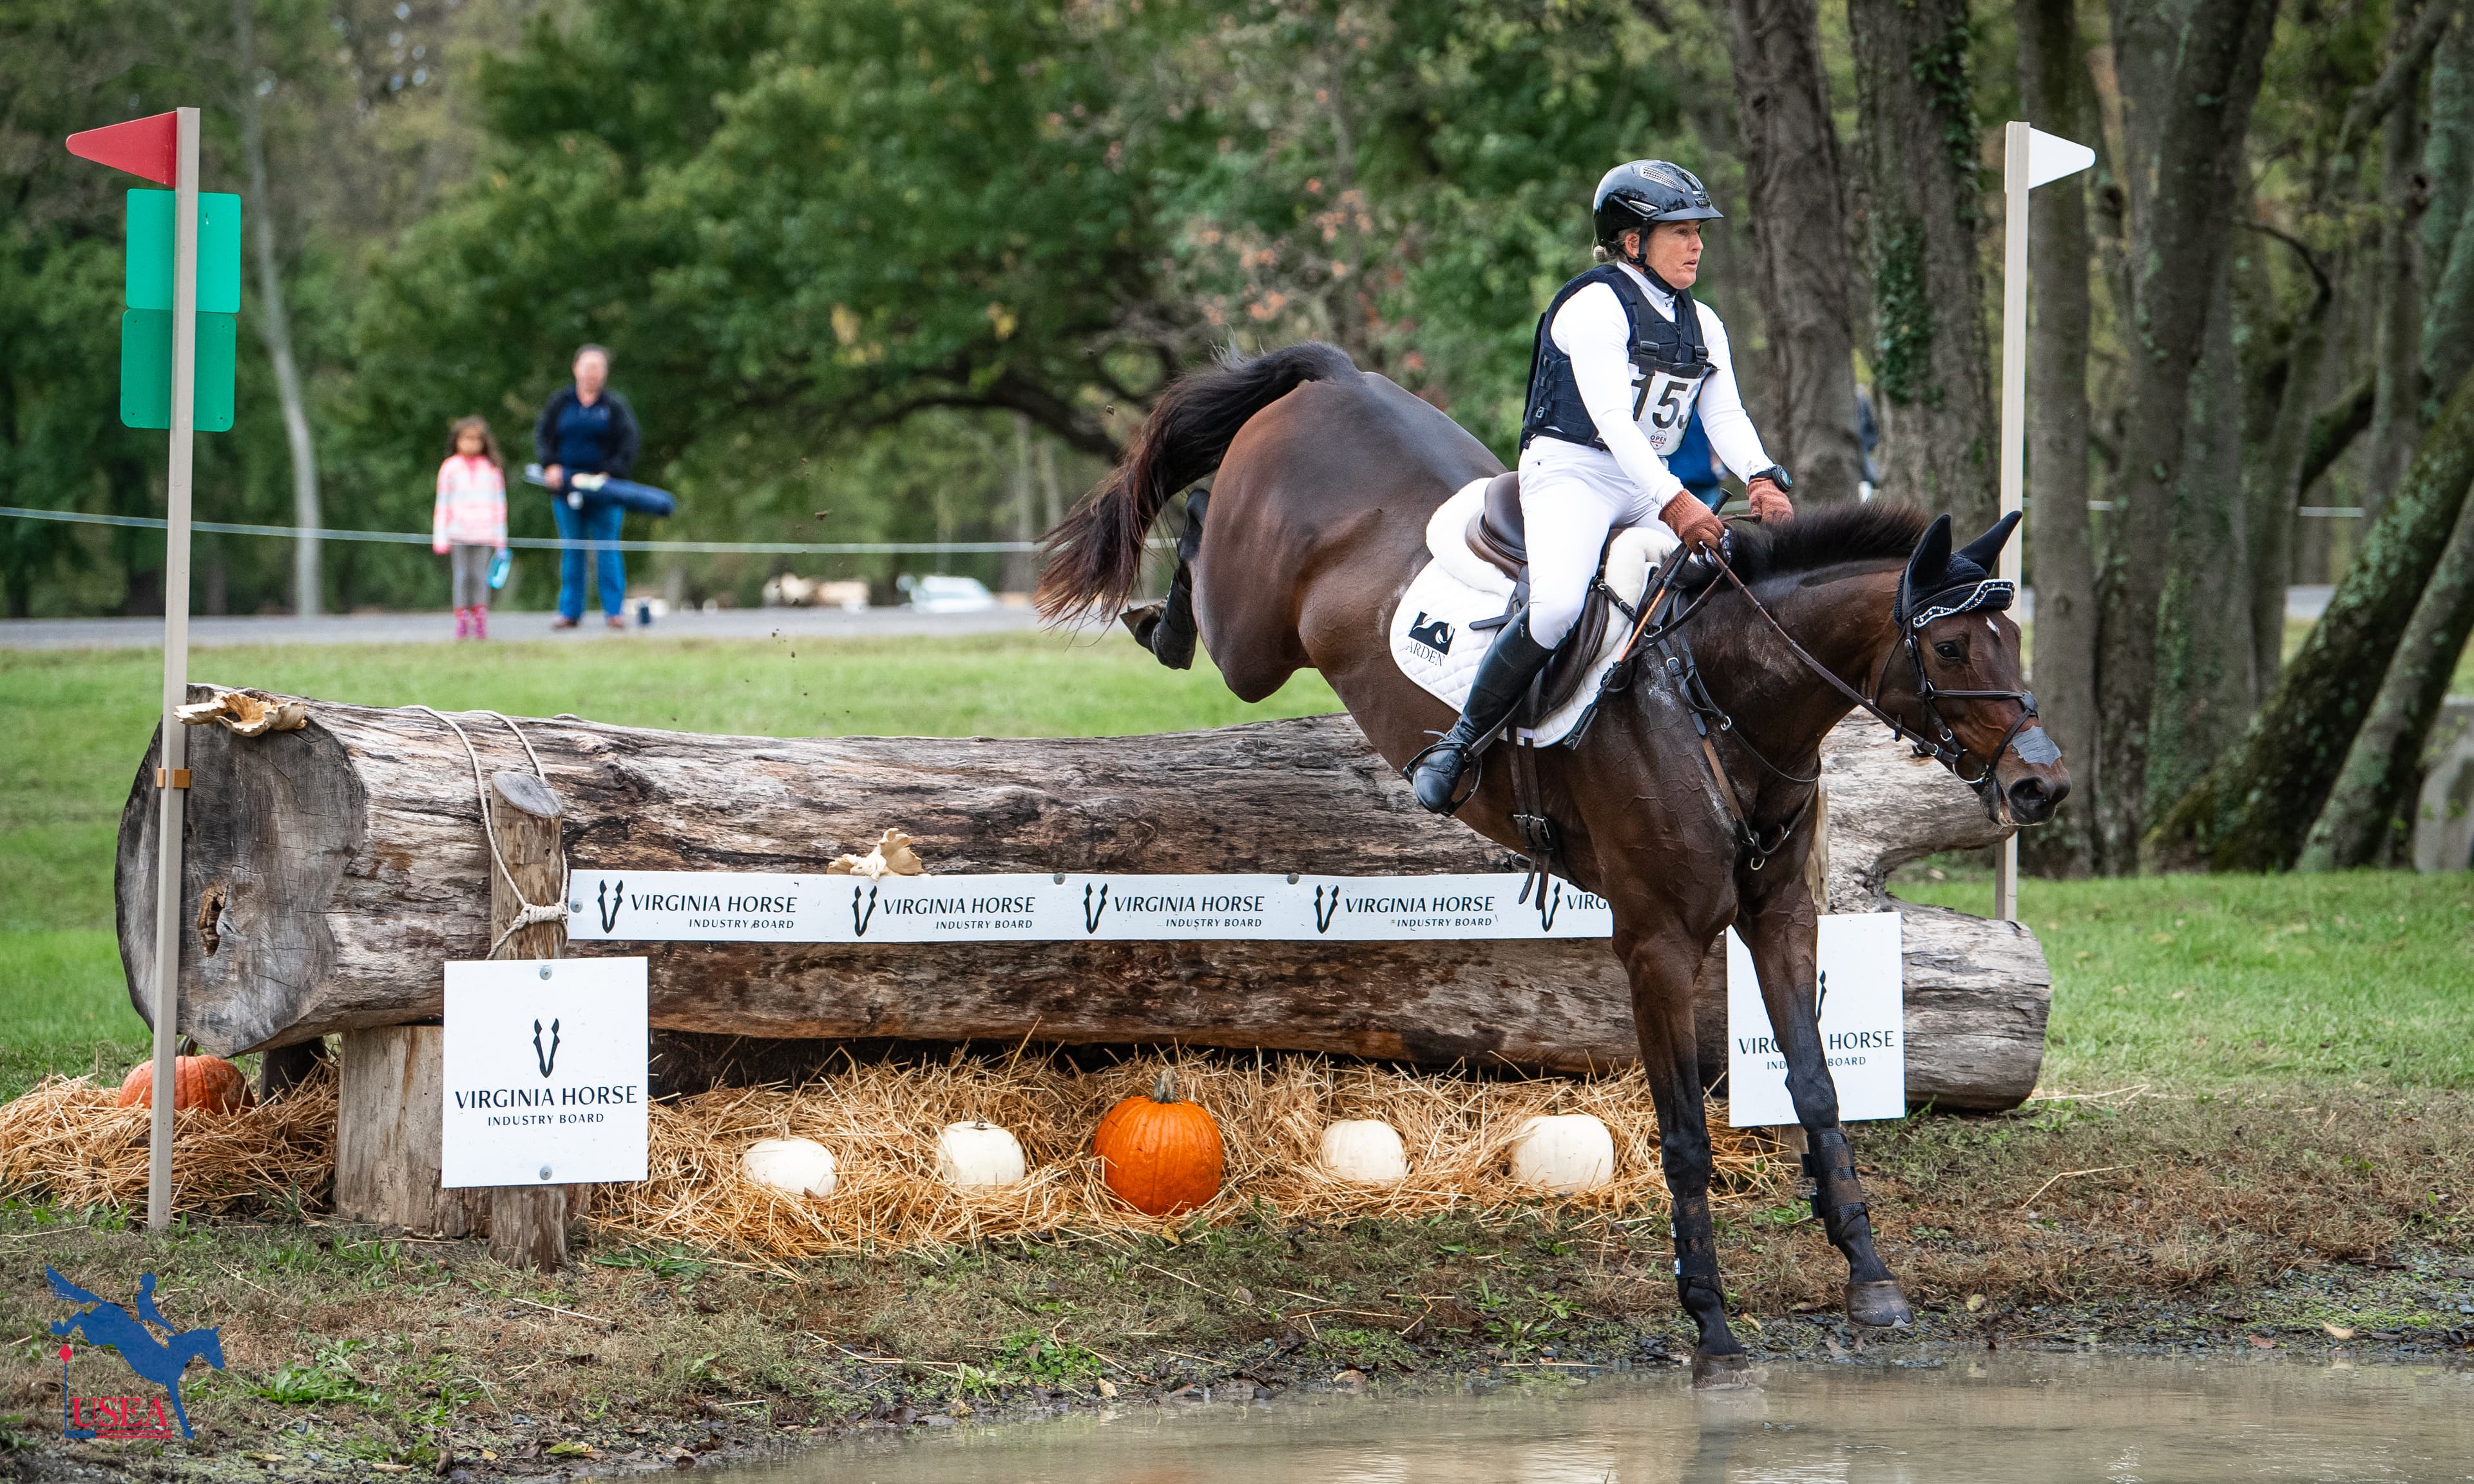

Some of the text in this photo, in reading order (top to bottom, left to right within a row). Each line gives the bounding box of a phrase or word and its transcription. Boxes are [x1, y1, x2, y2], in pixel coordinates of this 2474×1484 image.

[1405, 640, 1448, 667] ARDEN
[631, 894, 798, 913] VIRGINIA HORSE
[883, 897, 1036, 915] VIRGINIA HORSE
[1114, 895, 1265, 913] VIRGINIA HORSE
[1345, 896, 1495, 913] VIRGINIA HORSE
[689, 918, 794, 929] INDUSTRY BOARD
[935, 920, 1033, 930] INDUSTRY BOARD
[1165, 918, 1262, 928] INDUSTRY BOARD
[1397, 918, 1492, 928] INDUSTRY BOARD
[1829, 1031, 1895, 1051] HORSE
[1827, 1056, 1866, 1067] BOARD
[454, 1085, 637, 1109] VIRGINIA HORSE
[488, 1113, 604, 1127] INDUSTRY BOARD
